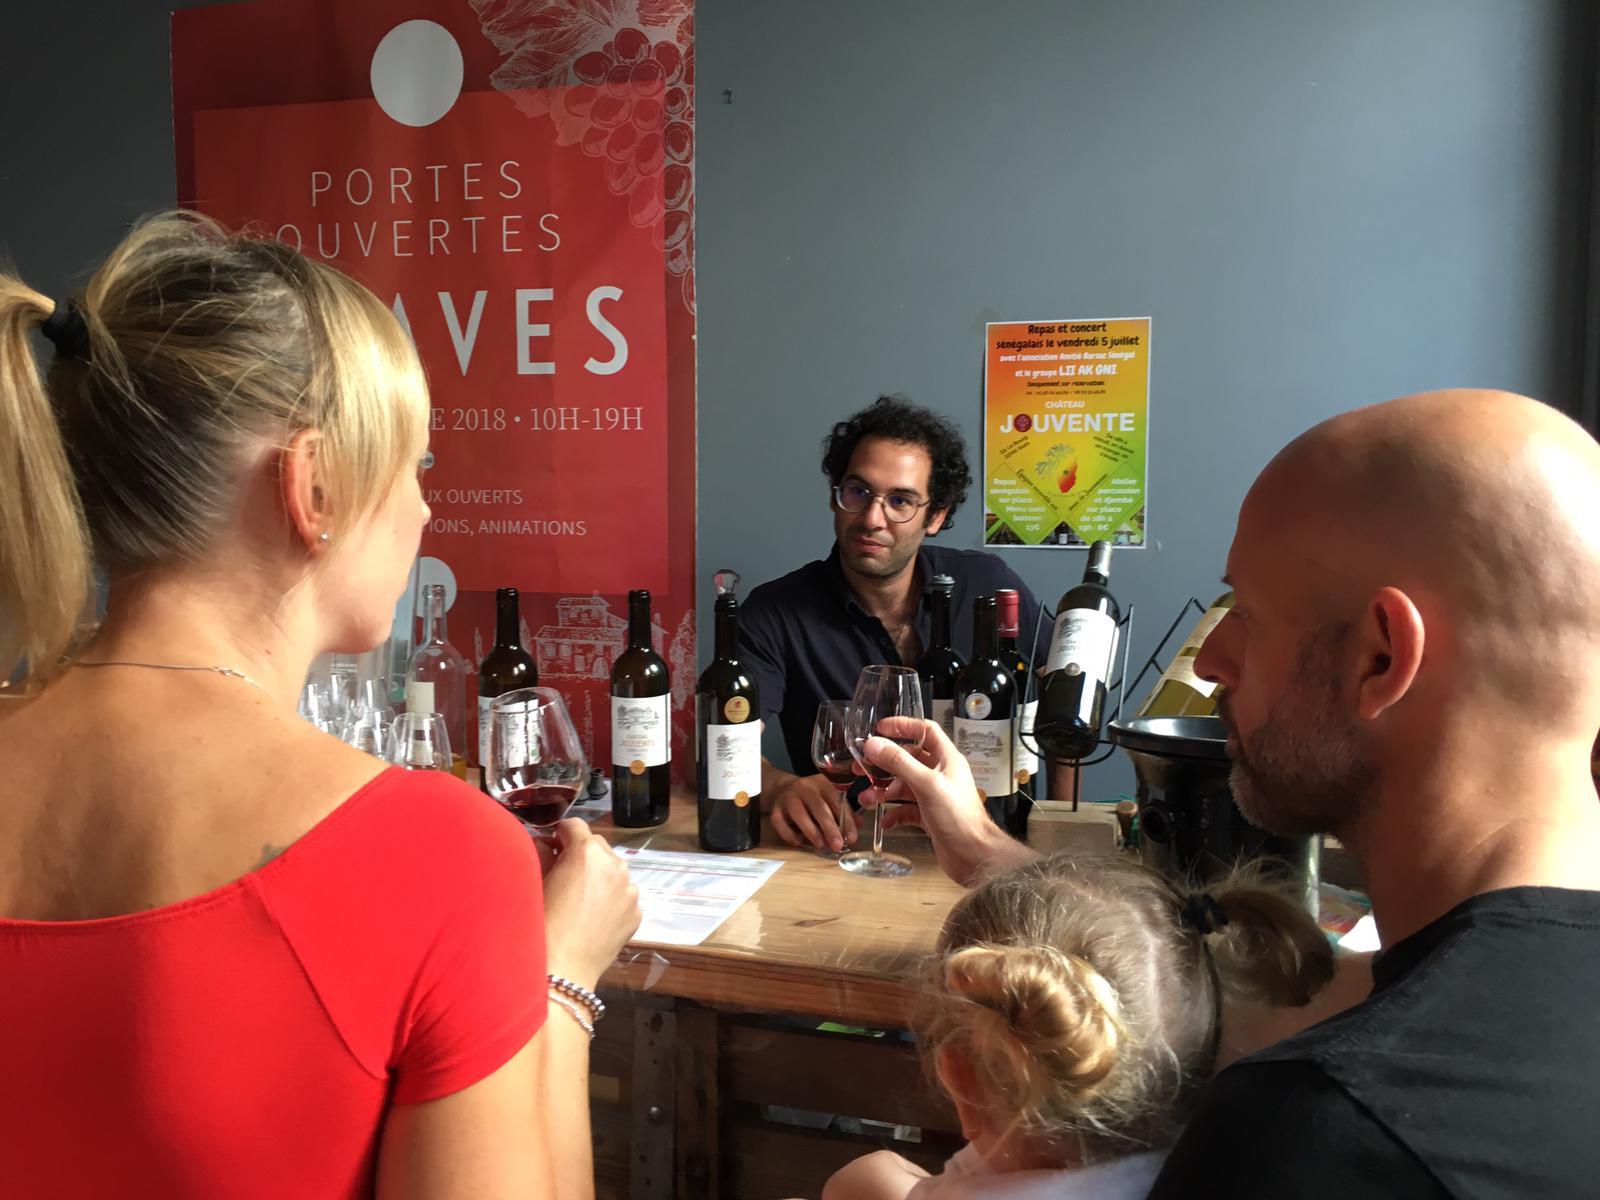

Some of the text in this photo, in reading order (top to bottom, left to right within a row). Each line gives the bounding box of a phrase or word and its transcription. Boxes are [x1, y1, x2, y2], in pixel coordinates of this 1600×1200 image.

[311, 160, 523, 207] PORTES
[276, 213, 562, 260] OUVERTES
[1028, 322, 1107, 336] Repas et concert
[1045, 338, 1055, 348] le
[1056, 336, 1099, 347] vendredi
[1101, 336, 1108, 346] 5
[1108, 335, 1140, 349] juillet
[1078, 364, 1093, 376] AK
[452, 407, 507, 431] 2018
[530, 406, 644, 431] 10H-19H
[446, 488, 524, 505] OUVERTS
[478, 519, 587, 536] ANIMATIONS
